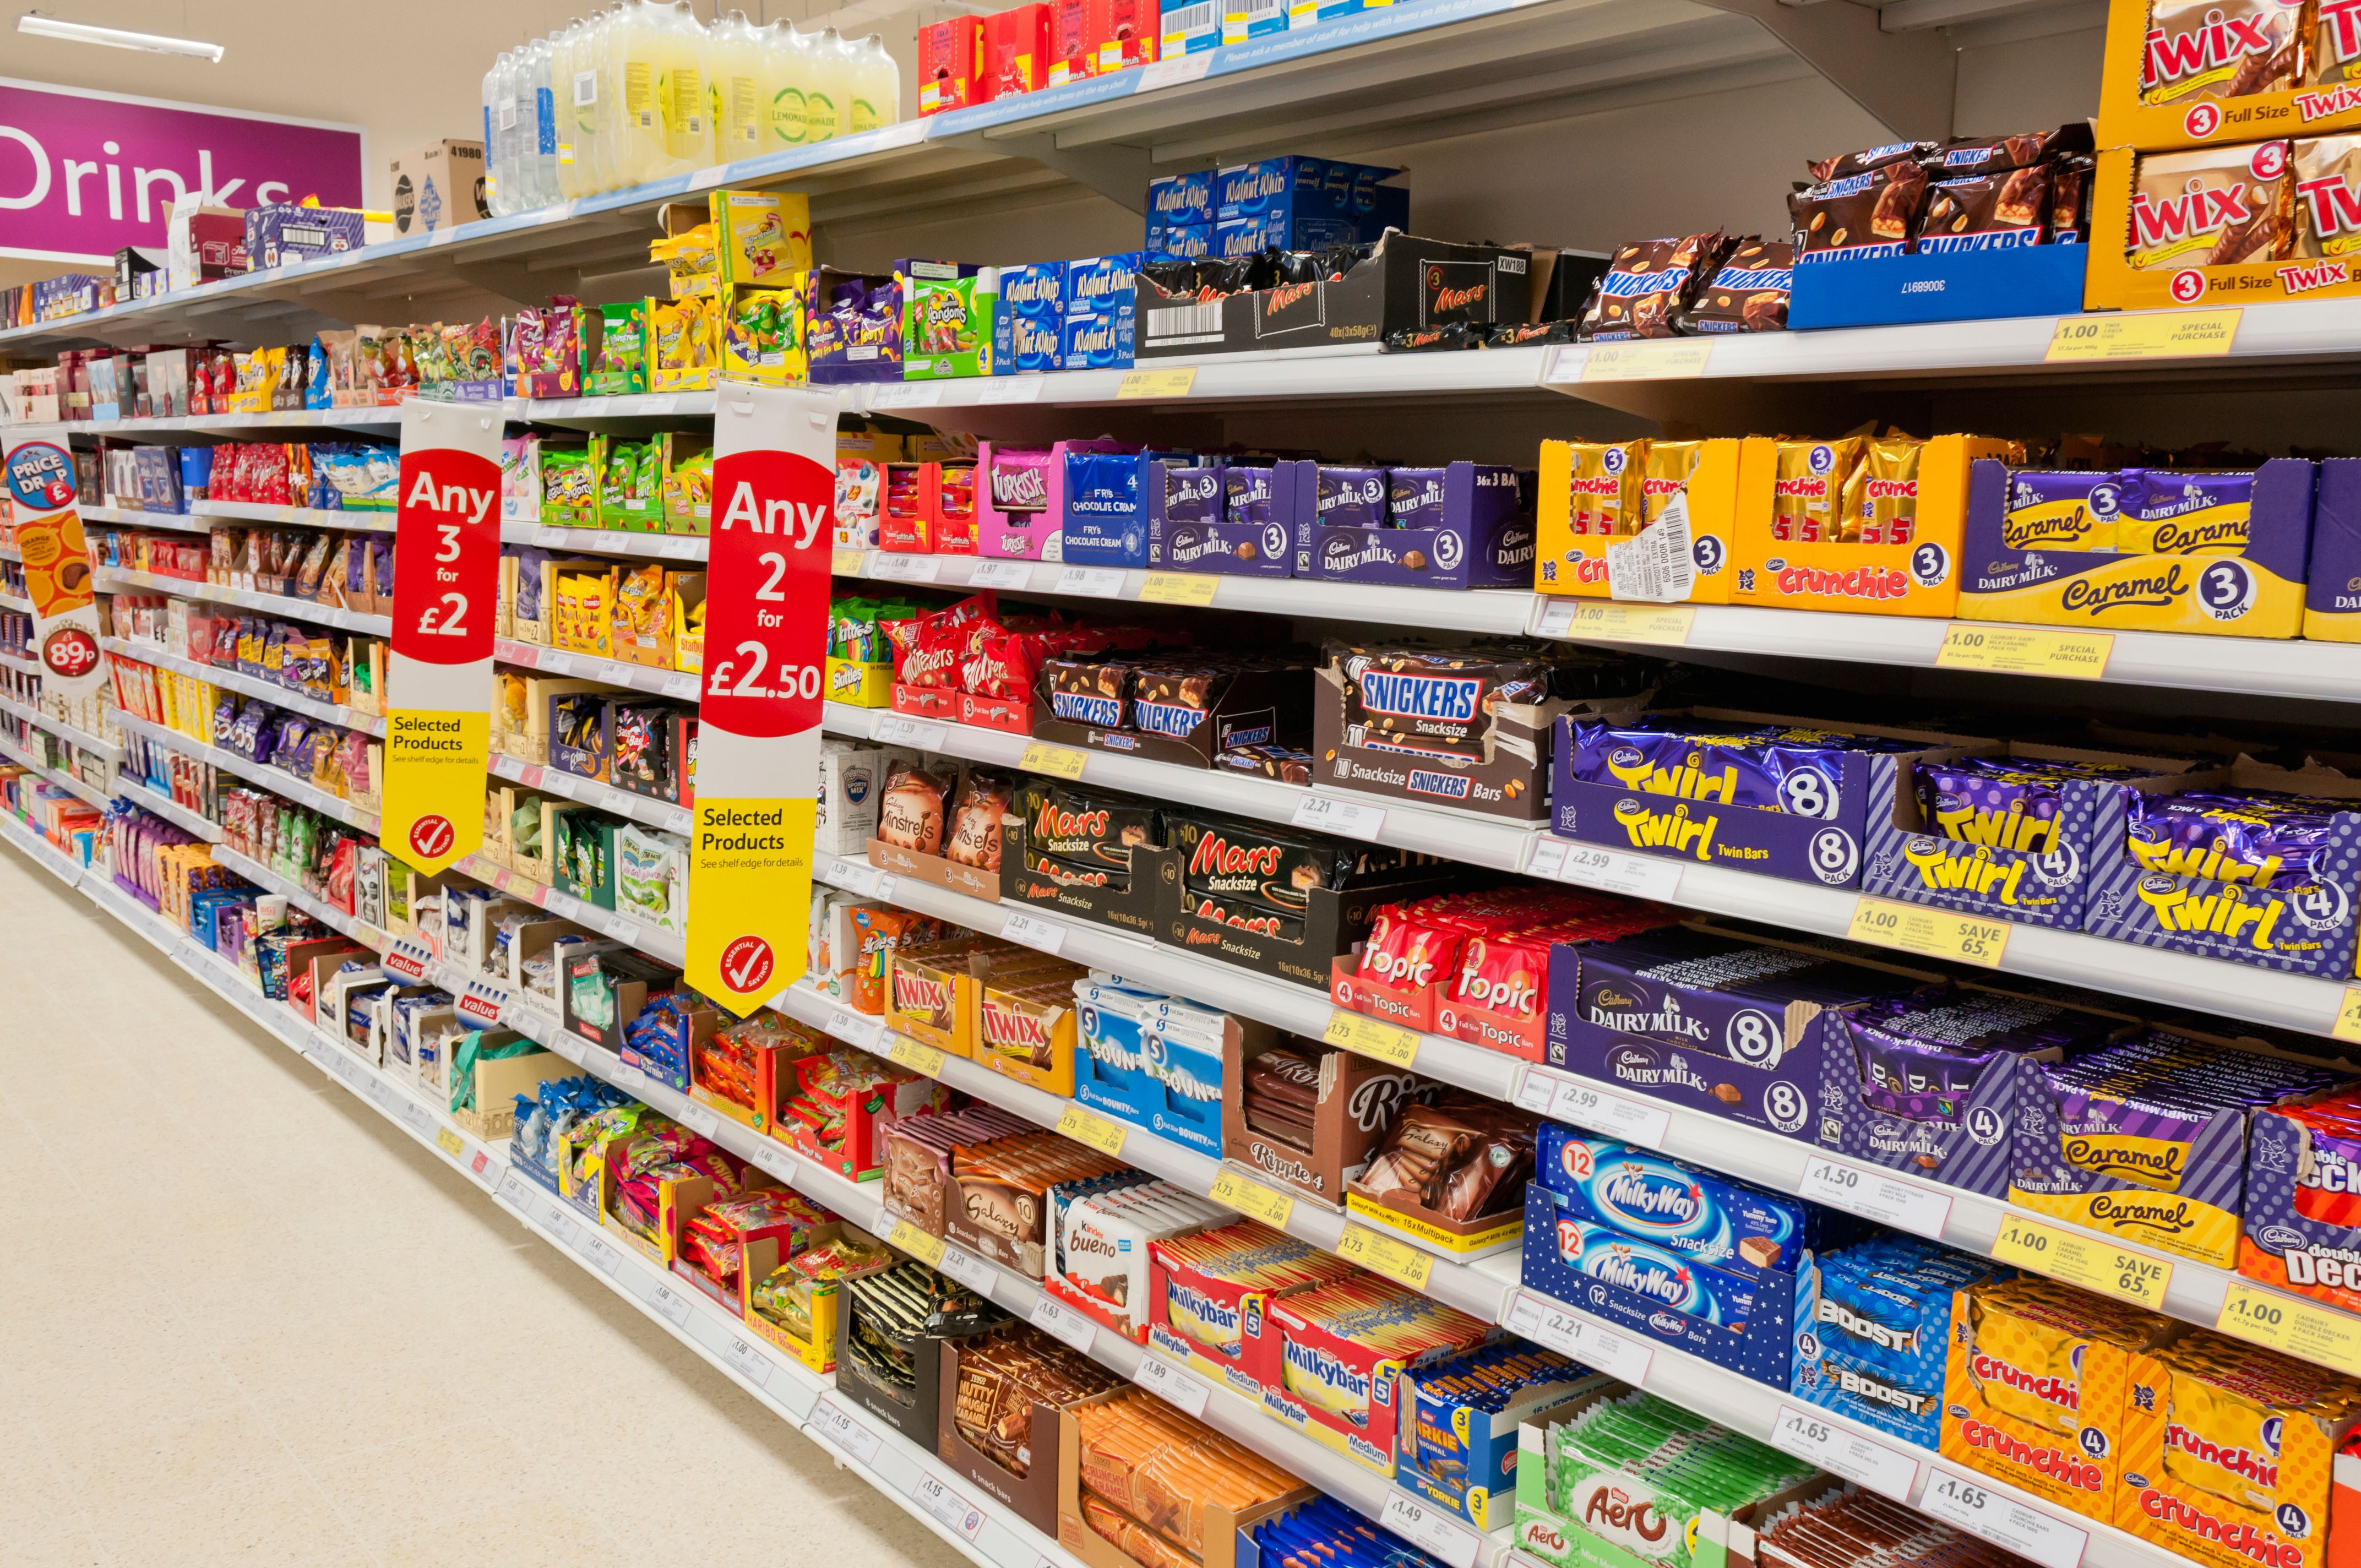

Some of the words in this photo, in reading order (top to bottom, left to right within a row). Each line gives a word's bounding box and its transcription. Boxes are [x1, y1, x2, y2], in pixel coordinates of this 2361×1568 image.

[772, 111, 808, 122] LEMONADE
[2194, 105, 2210, 134] 3
[2225, 106, 2251, 124] Full
[2255, 106, 2289, 121] Size
[450, 145, 482, 160] 41980
[0, 126, 290, 224] Drinks
[1499, 258, 1525, 273] XW188
[1006, 279, 1036, 303] Walnut
[1037, 275, 1059, 304] Whip
[1901, 281, 1945, 293] 30068917
[2179, 273, 2196, 301] 3
[2210, 277, 2235, 290] Full
[2239, 275, 2272, 289] Size
[1434, 284, 1485, 313] Mars
[926, 304, 966, 325] Randoms
[1699, 320, 1738, 332] SNICKERS
[2054, 325, 2098, 339] £1.00
[2172, 330, 2226, 340] PURCHASE
[2182, 323, 2222, 331] SPECIAL
[980, 346, 987, 361] 4
[12, 452, 63, 477] PRICE
[993, 465, 1045, 502] TURKISH
[405, 471, 494, 524] Any
[720, 481, 827, 549] Any
[435, 525, 461, 563] 3
[1065, 536, 1100, 547] CHOCOLATE
[1100, 537, 1122, 548] CREAM
[1266, 526, 1282, 551] 3
[1657, 529, 1666, 541] 149
[1325, 553, 1359, 570] DAIRY
[1361, 546, 1396, 565] MILK
[1660, 543, 1669, 563] DOOR
[437, 568, 458, 582] for
[755, 552, 785, 601] 2
[1653, 563, 1663, 596] NORTHCOTT
[1662, 565, 1671, 582] 6506
[1922, 573, 1945, 587] PACK
[2063, 564, 2189, 616] Caramel
[417, 592, 469, 636] £2
[757, 609, 784, 628] for
[1655, 617, 1683, 625] SPECIAL
[2214, 602, 2248, 620] PACK
[1649, 623, 1684, 632] PURCHASE
[1944, 633, 1984, 647] £1.00
[2058, 645, 2096, 654] SPECIAL
[50, 641, 95, 666] 89p
[2049, 653, 2099, 663] PURCHASE
[708, 641, 820, 698] £2.50
[1364, 674, 1481, 720] SNICKERS
[394, 716, 461, 732] Selected
[1416, 720, 1467, 737] Snacksize
[393, 736, 463, 751] Products
[1106, 735, 1134, 749] SNICKERS
[407, 754, 426, 763] shelf
[426, 755, 444, 764] edge
[445, 755, 455, 764] for
[1337, 760, 1348, 774] 10
[1351, 764, 1405, 786] Snacksize
[1411, 772, 1467, 797] SNICKERS
[1473, 783, 1502, 801] Bars
[703, 808, 782, 826] Selected
[1035, 799, 1109, 838] Mars
[413, 819, 438, 838] ESSENTIAL
[702, 833, 785, 851] Products
[1048, 839, 1089, 852] Snacksize
[1718, 843, 1743, 858] Twin
[1744, 846, 1769, 860] Bars
[1190, 831, 1282, 876] Mars
[1573, 851, 1609, 869] £2.99
[1208, 875, 1257, 891] Snacksize
[2137, 885, 2285, 950] Twirl
[1958, 923, 2001, 941] SAVE
[1961, 939, 1989, 957] 65p
[2279, 940, 2300, 951] Twin
[2301, 940, 2321, 950] Bars
[387, 956, 425, 976] value
[748, 960, 769, 987] SAVINGS
[1458, 968, 1536, 1014] Topic
[1598, 989, 1633, 1008] Cadbury
[459, 998, 500, 1019] value
[529, 998, 540, 1008] Fruit
[1326, 1024, 1350, 1038] £1.73
[1386, 1046, 1409, 1059] £3.00
[640, 1058, 663, 1080] Starmix
[1615, 1064, 1662, 1083] DAIRY
[1662, 1069, 1707, 1092] MILK
[1103, 1097, 1131, 1115] BOUNTY
[1562, 1088, 1598, 1108] £2.99
[1772, 1086, 1794, 1118] 8
[772, 1126, 794, 1147] HARIBO
[1179, 1128, 1208, 1147] BOUNTY
[1401, 1126, 1450, 1154] Galaxy
[1251, 1141, 1310, 1182] Ripple
[1569, 1147, 1590, 1176] 12
[1814, 1166, 1859, 1188] £1.50
[2090, 1195, 2195, 1234] Caramel
[1081, 1219, 1104, 1239] kinder
[2263, 1229, 2300, 1247] Cadbury
[1070, 1229, 1116, 1259] bueno
[2001, 1228, 2047, 1251] £1.00
[2114, 1255, 2162, 1280] SAVE
[2119, 1273, 2150, 1297] 65p
[1169, 1278, 1238, 1329] Milkybar
[1547, 1315, 1582, 1338] £2.21
[1819, 1298, 1912, 1352] BOOST
[2296, 1314, 2329, 1327] CADBURY
[972, 1374, 986, 1382] TESCO
[1144, 1359, 1166, 1378] £1.89
[1287, 1341, 1369, 1397] Milkybar
[959, 1380, 994, 1400] NUTTY
[1375, 1382, 1388, 1402] 5
[1841, 1370, 1925, 1415] BOOST
[958, 1396, 991, 1415] NOUGAT
[956, 1407, 987, 1427] CARAMEL
[1786, 1417, 1830, 1443] £1.65
[1348, 1434, 1388, 1462] Medium
[2087, 1430, 2102, 1452] 4
[923, 1479, 943, 1497] £1.15
[972, 1469, 977, 1479] 8
[977, 1472, 997, 1493] snack
[997, 1485, 1011, 1503] bars
[1937, 1480, 1987, 1509] £1.65
[1426, 1484, 1461, 1511] YORKIE
[1391, 1500, 1422, 1522] £1.49
[2283, 1511, 2300, 1529] 4
[2286, 1531, 2306, 1539] PACK
